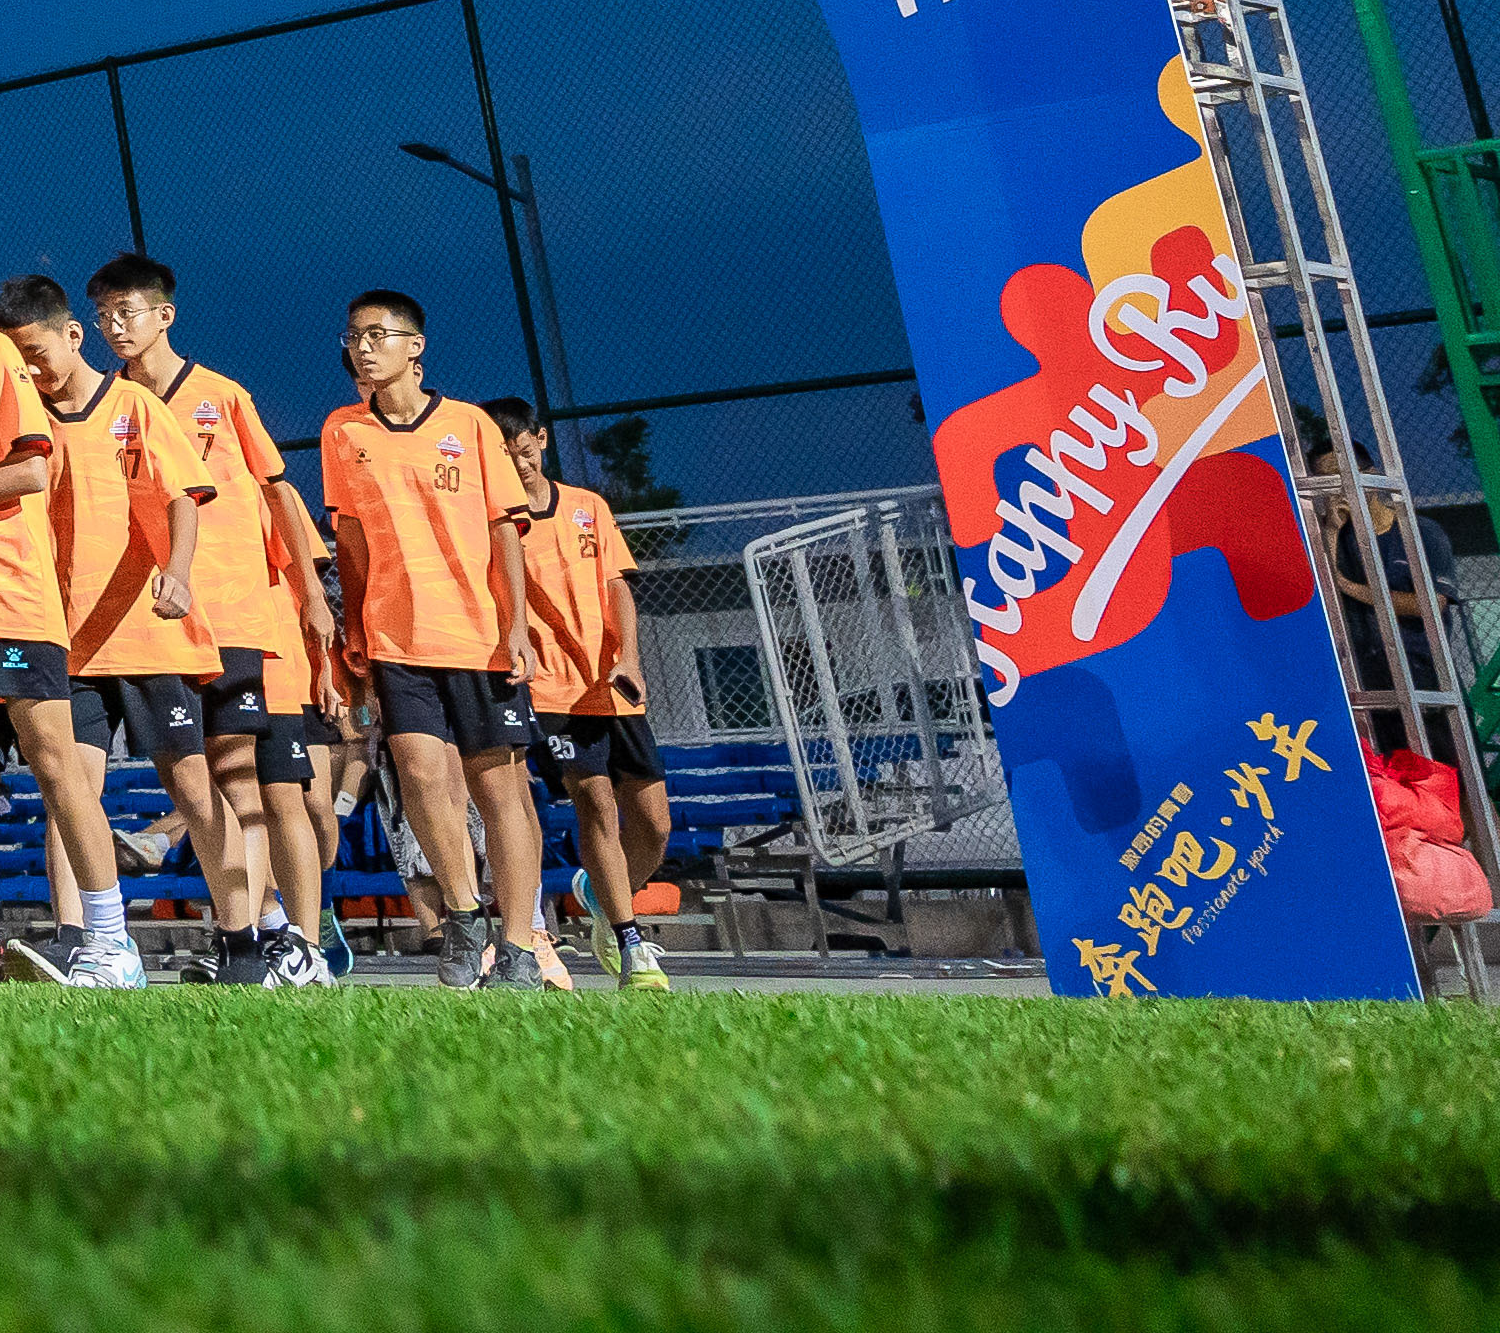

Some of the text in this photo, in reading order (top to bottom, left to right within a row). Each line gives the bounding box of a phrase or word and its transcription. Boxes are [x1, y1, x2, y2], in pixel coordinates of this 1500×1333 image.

[197, 432, 215, 462] 7
[115, 447, 142, 481] 17
[433, 463, 460, 493] 30
[547, 734, 576, 760] 25
